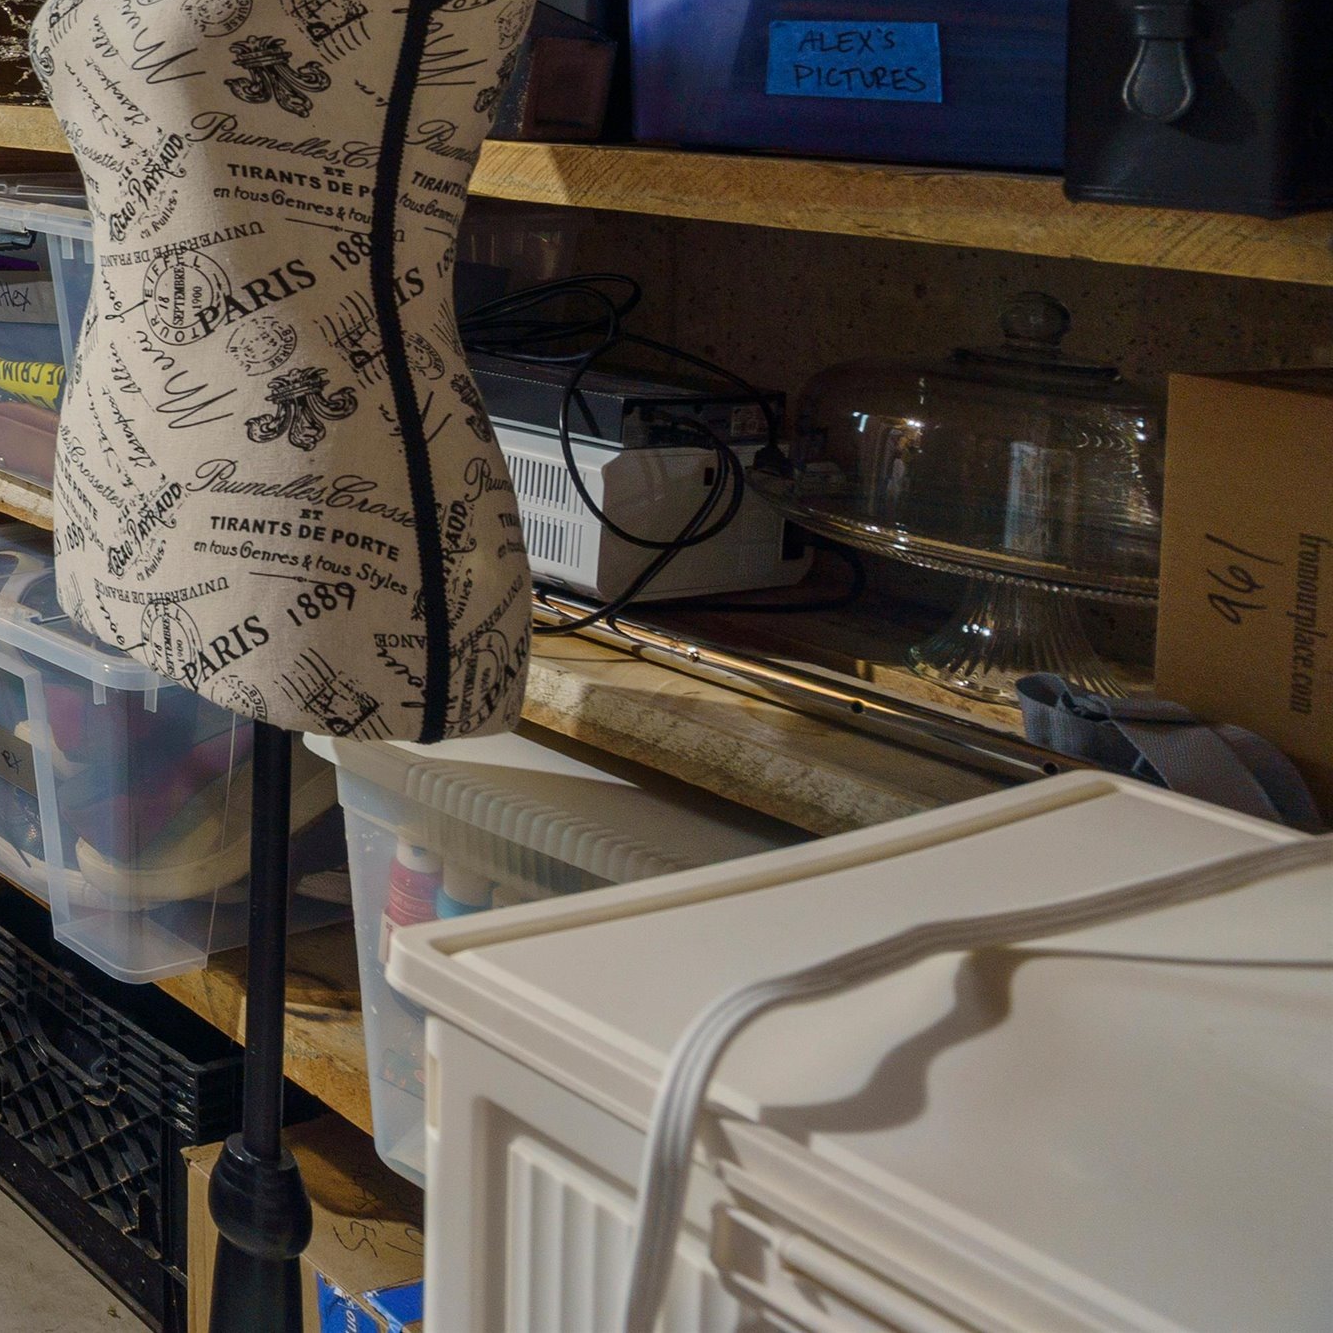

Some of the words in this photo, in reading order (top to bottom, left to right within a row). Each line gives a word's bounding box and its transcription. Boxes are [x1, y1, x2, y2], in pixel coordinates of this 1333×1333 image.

[793, 65, 927, 94] PICTURES
[226, 163, 322, 191] TIRANTS
[327, 178, 352, 196] DE
[213, 186, 231, 199] en
[233, 184, 270, 203] tous
[270, 187, 334, 216] Genres
[335, 203, 346, 219] &
[348, 205, 372, 225] tou
[157, 295, 171, 310] 18
[172, 254, 186, 327] SEPTEMBRE
[191, 284, 203, 310] 1900
[192, 258, 317, 339] PARIS
[330, 232, 373, 273] 188
[299, 508, 324, 521] ET
[326, 474, 417, 528] Crosse
[210, 515, 292, 537] TIRANTS
[298, 523, 327, 542] DE
[331, 528, 400, 562] PORTE
[193, 540, 208, 554] en
[209, 539, 238, 557] tous
[239, 539, 299, 567] Genres
[301, 554, 313, 572] &
[316, 554, 353, 577] tous
[355, 562, 409, 597] Styles
[180, 613, 271, 694] PARIS
[286, 581, 357, 629] 1889
[373, 633, 428, 650] ANCE
[1288, 532, 1330, 717] fromourplace.com
